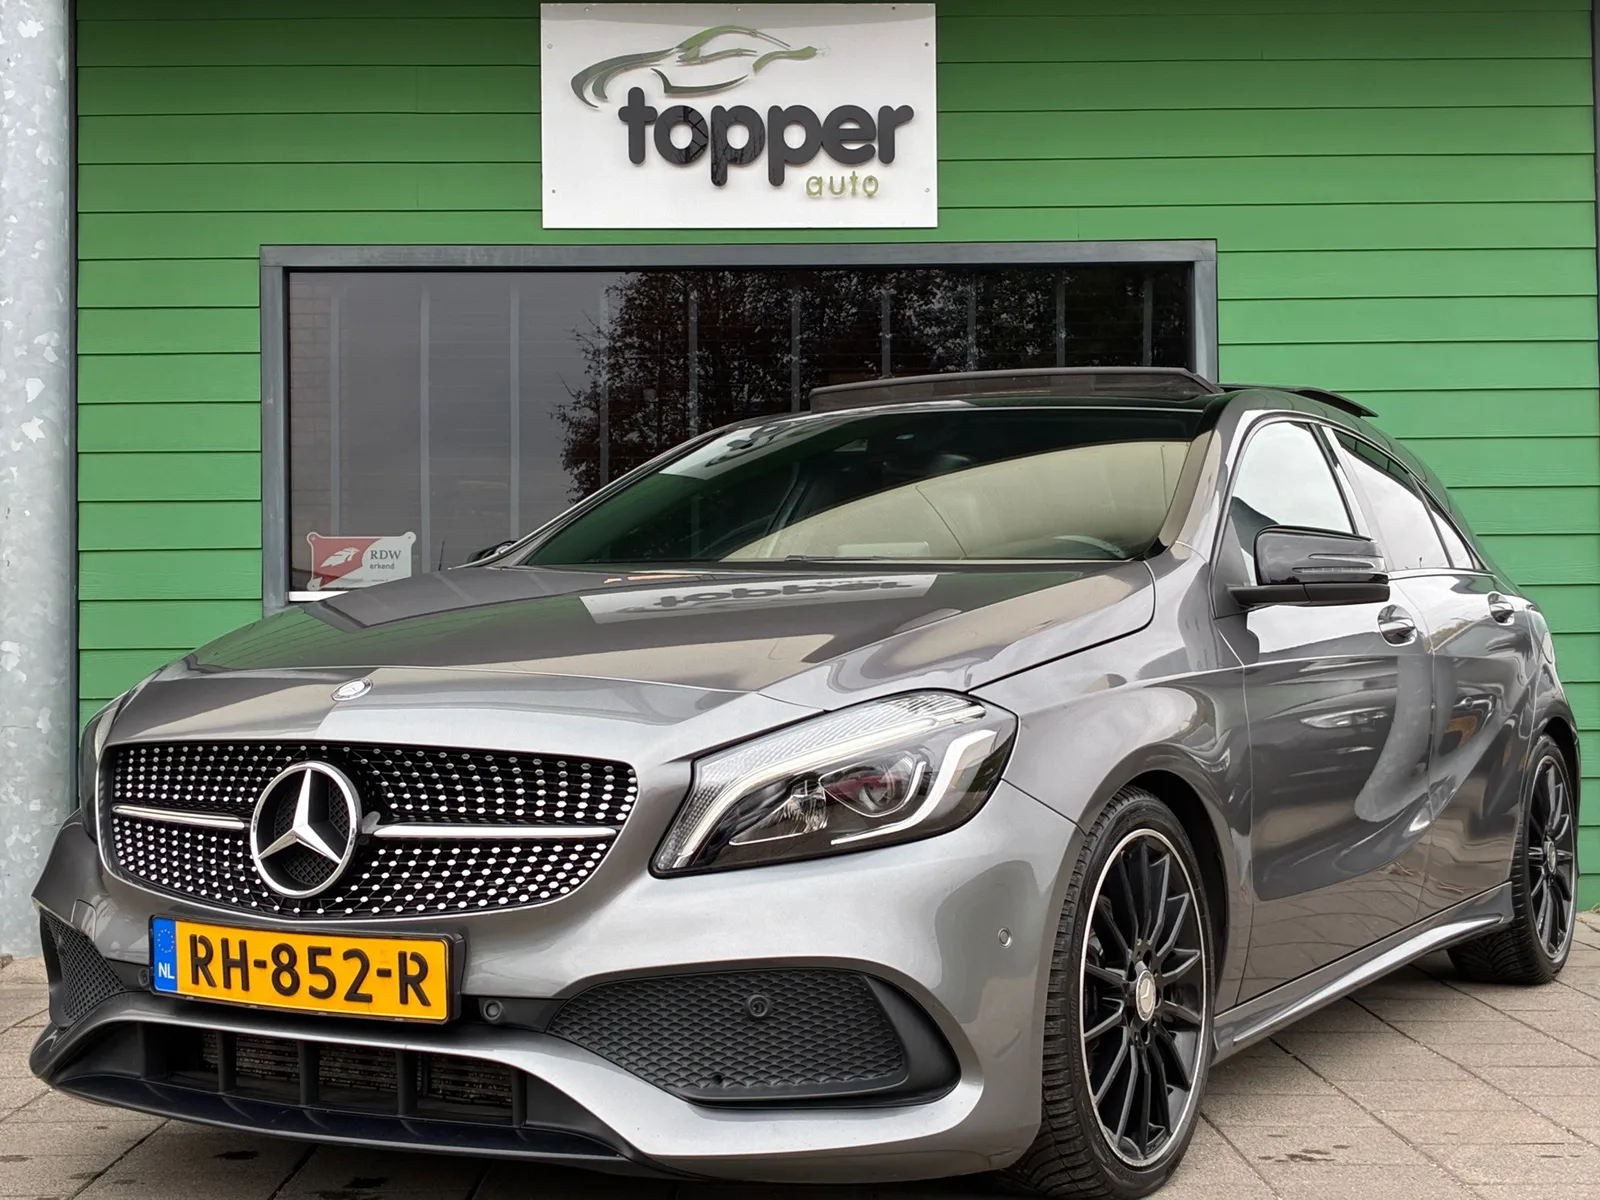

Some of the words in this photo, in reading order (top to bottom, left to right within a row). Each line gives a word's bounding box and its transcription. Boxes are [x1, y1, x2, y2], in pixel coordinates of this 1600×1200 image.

[617, 86, 914, 187] topper
[805, 170, 880, 197] auto
[369, 562, 395, 570] erkend
[370, 549, 402, 560] RDW
[157, 961, 176, 980] NL
[189, 933, 432, 1007] RH-852-R
